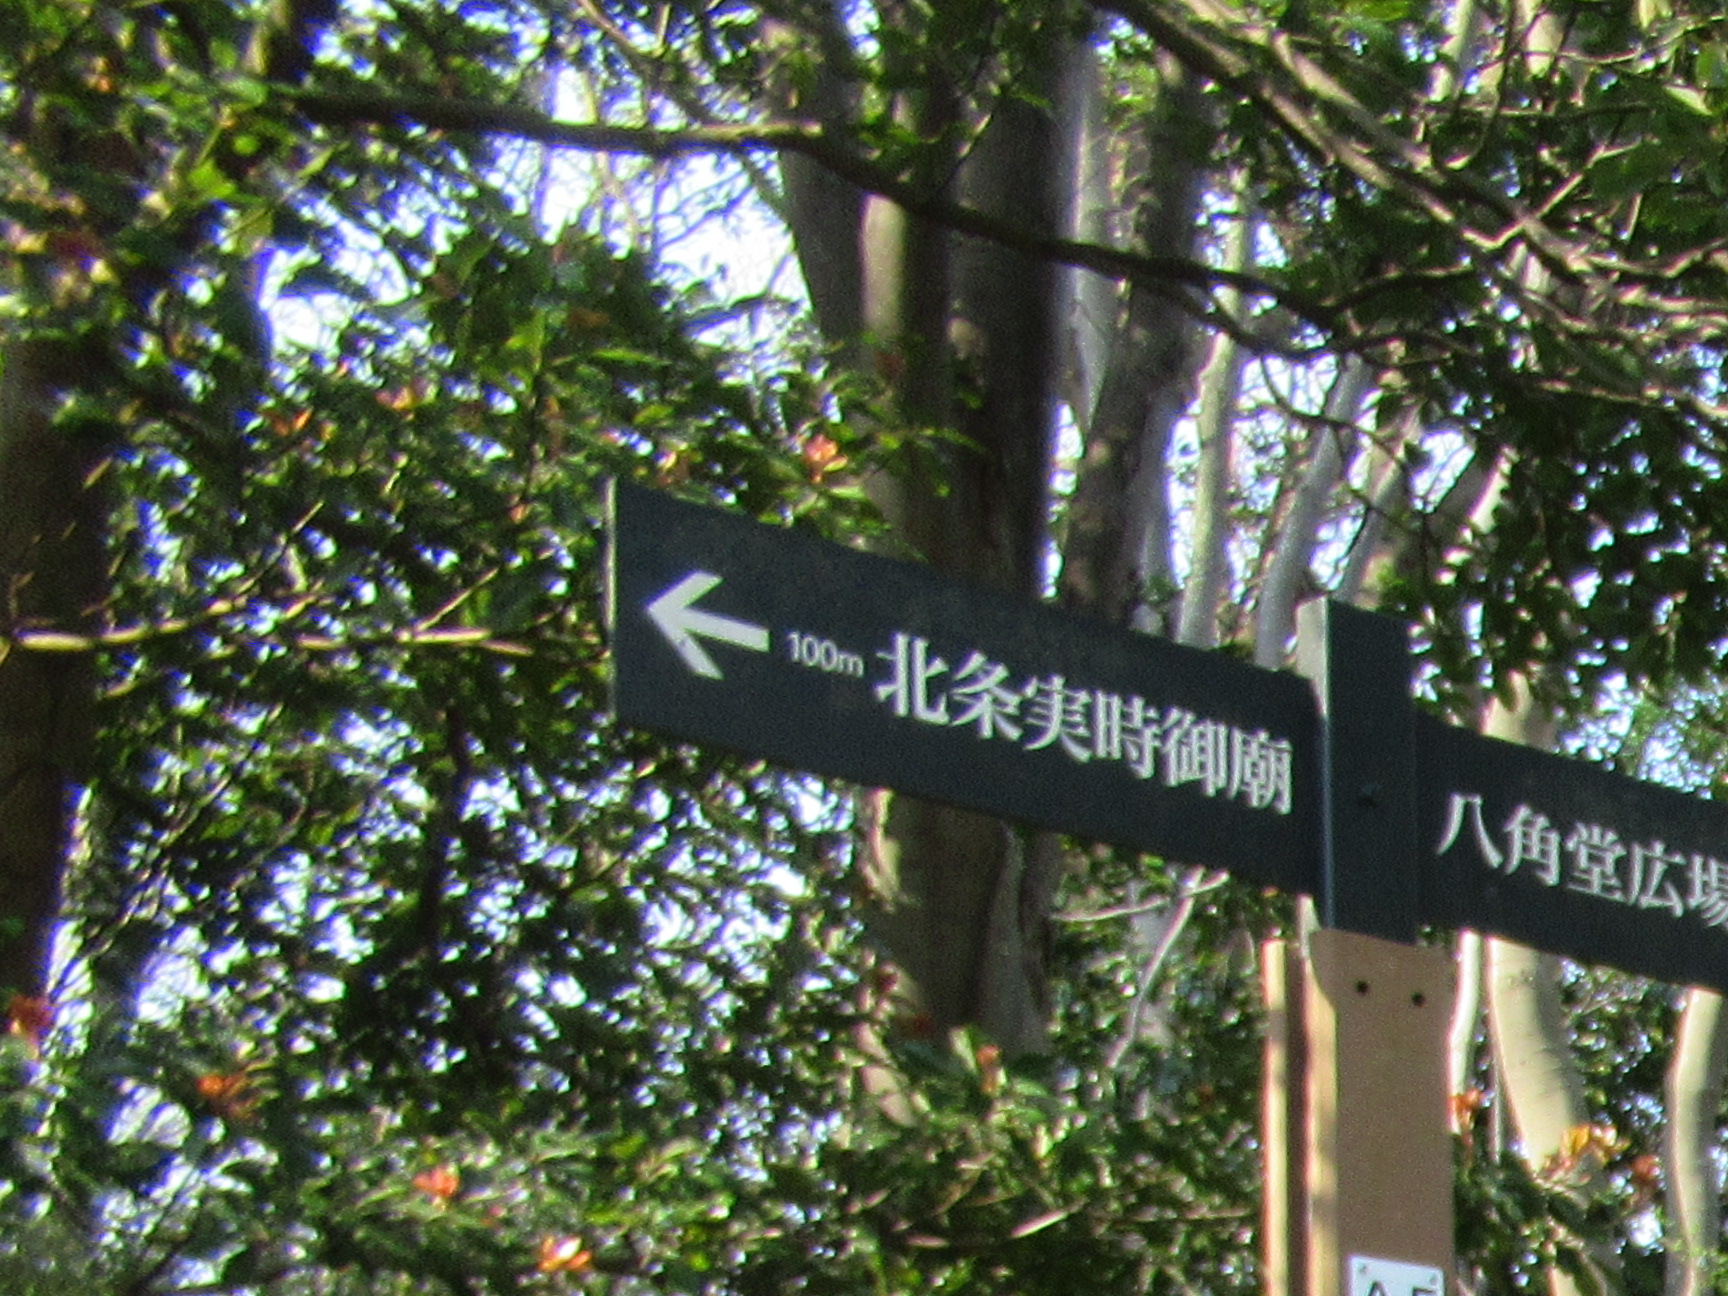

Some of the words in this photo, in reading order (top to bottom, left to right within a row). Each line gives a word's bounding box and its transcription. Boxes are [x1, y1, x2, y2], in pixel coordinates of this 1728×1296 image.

[787, 630, 864, 677] 100m
[875, 631, 1291, 815] 北条実時御廟
